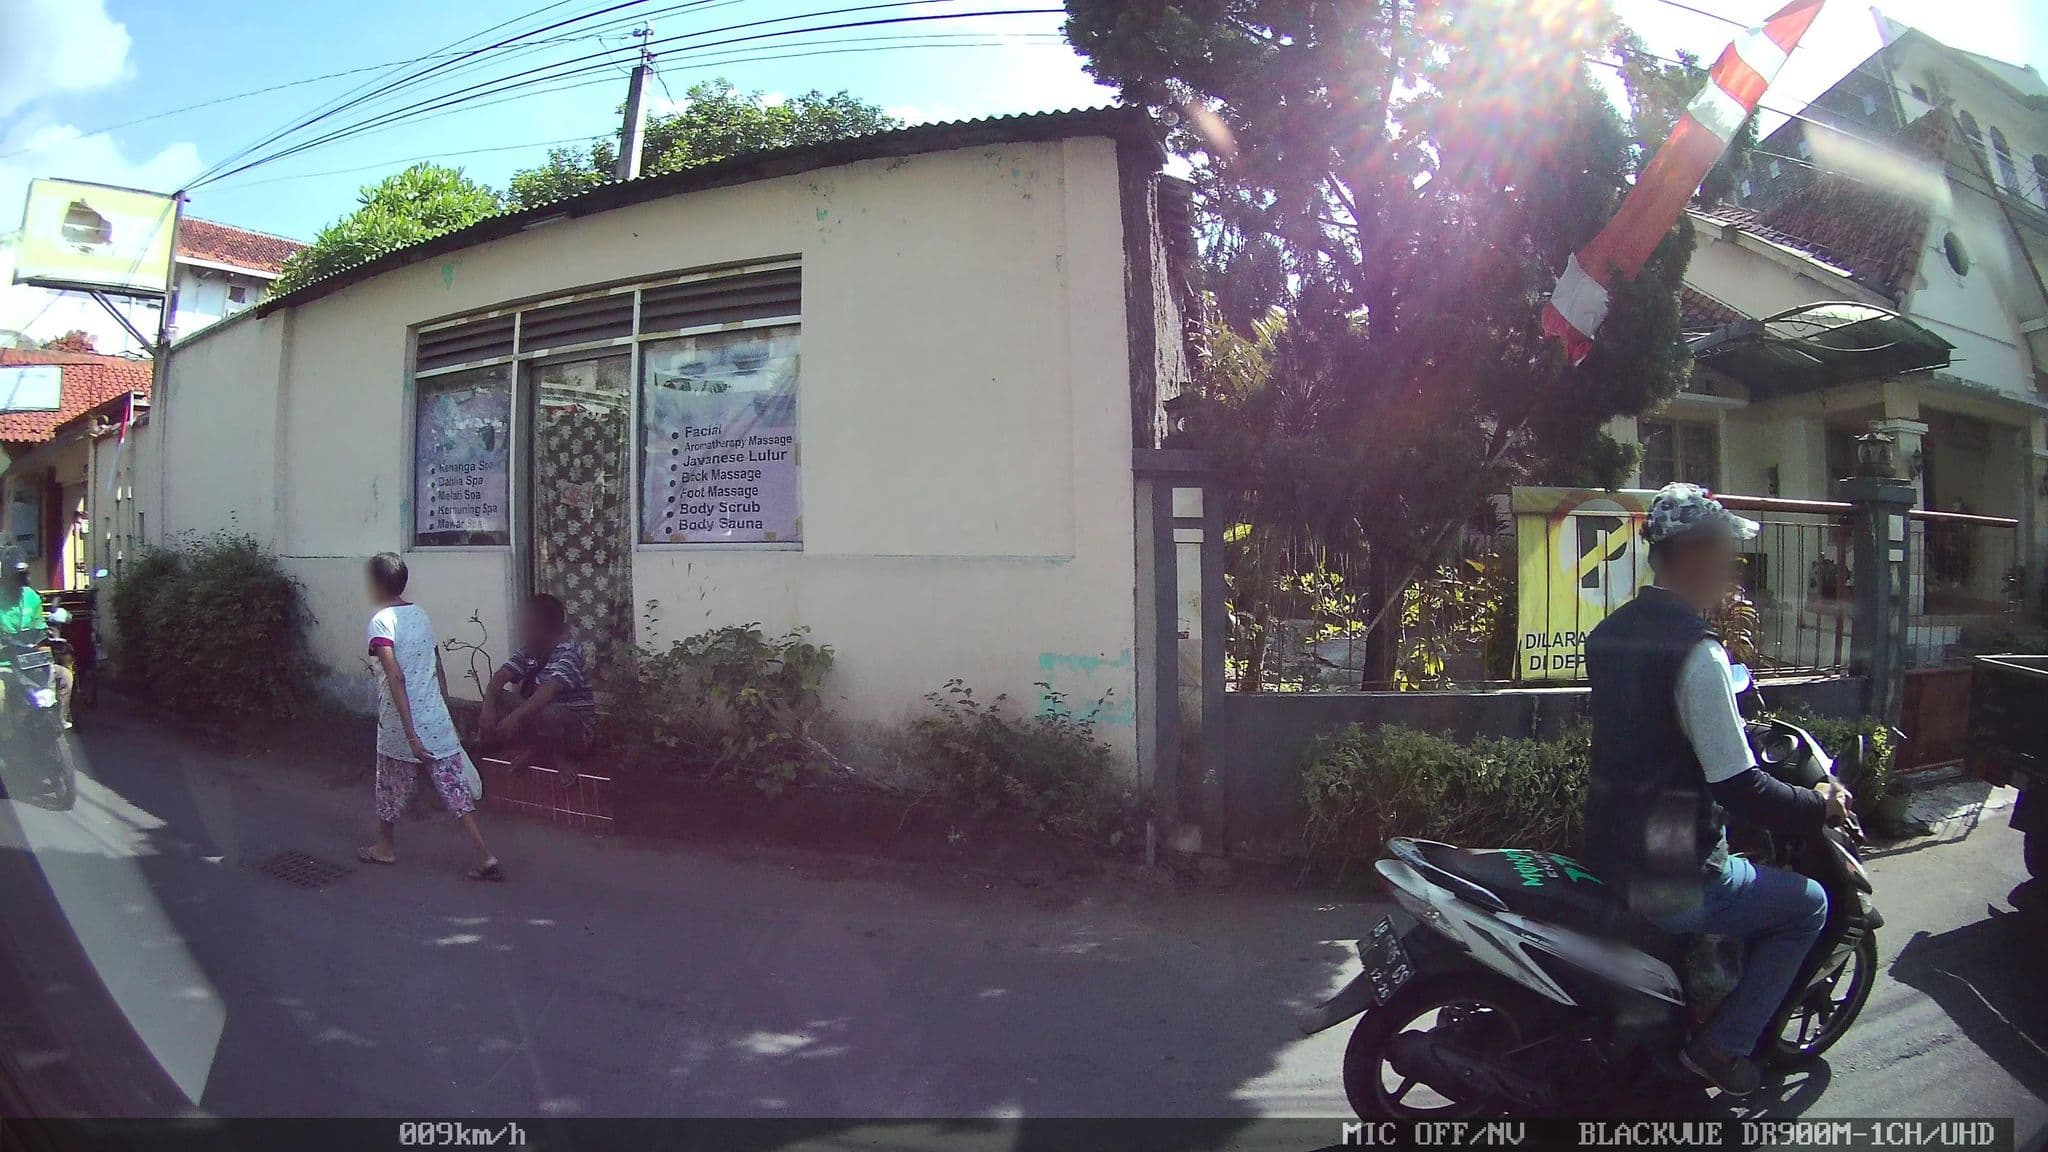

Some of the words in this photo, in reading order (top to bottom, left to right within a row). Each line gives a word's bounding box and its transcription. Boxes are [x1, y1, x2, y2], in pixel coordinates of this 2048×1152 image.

[685, 425, 722, 438] Facial
[748, 435, 793, 447] Massage
[683, 452, 744, 467] Javanese
[748, 449, 788, 462] Lulur
[439, 462, 476, 474] Kenanga
[465, 475, 484, 488] Spa
[682, 470, 708, 483] Back
[711, 469, 762, 482] Massage
[464, 489, 481, 501] Spa
[680, 487, 705, 499] Foot
[708, 485, 759, 499] Massage
[482, 502, 498, 516] Spa
[679, 503, 715, 517] Body
[719, 500, 761, 514] Scrub
[679, 519, 715, 532] Body
[719, 517, 763, 530] Sauna
[1525, 631, 1587, 650] DILARA
[1529, 655, 1547, 671] DI
[1552, 654, 1587, 670] DEP
